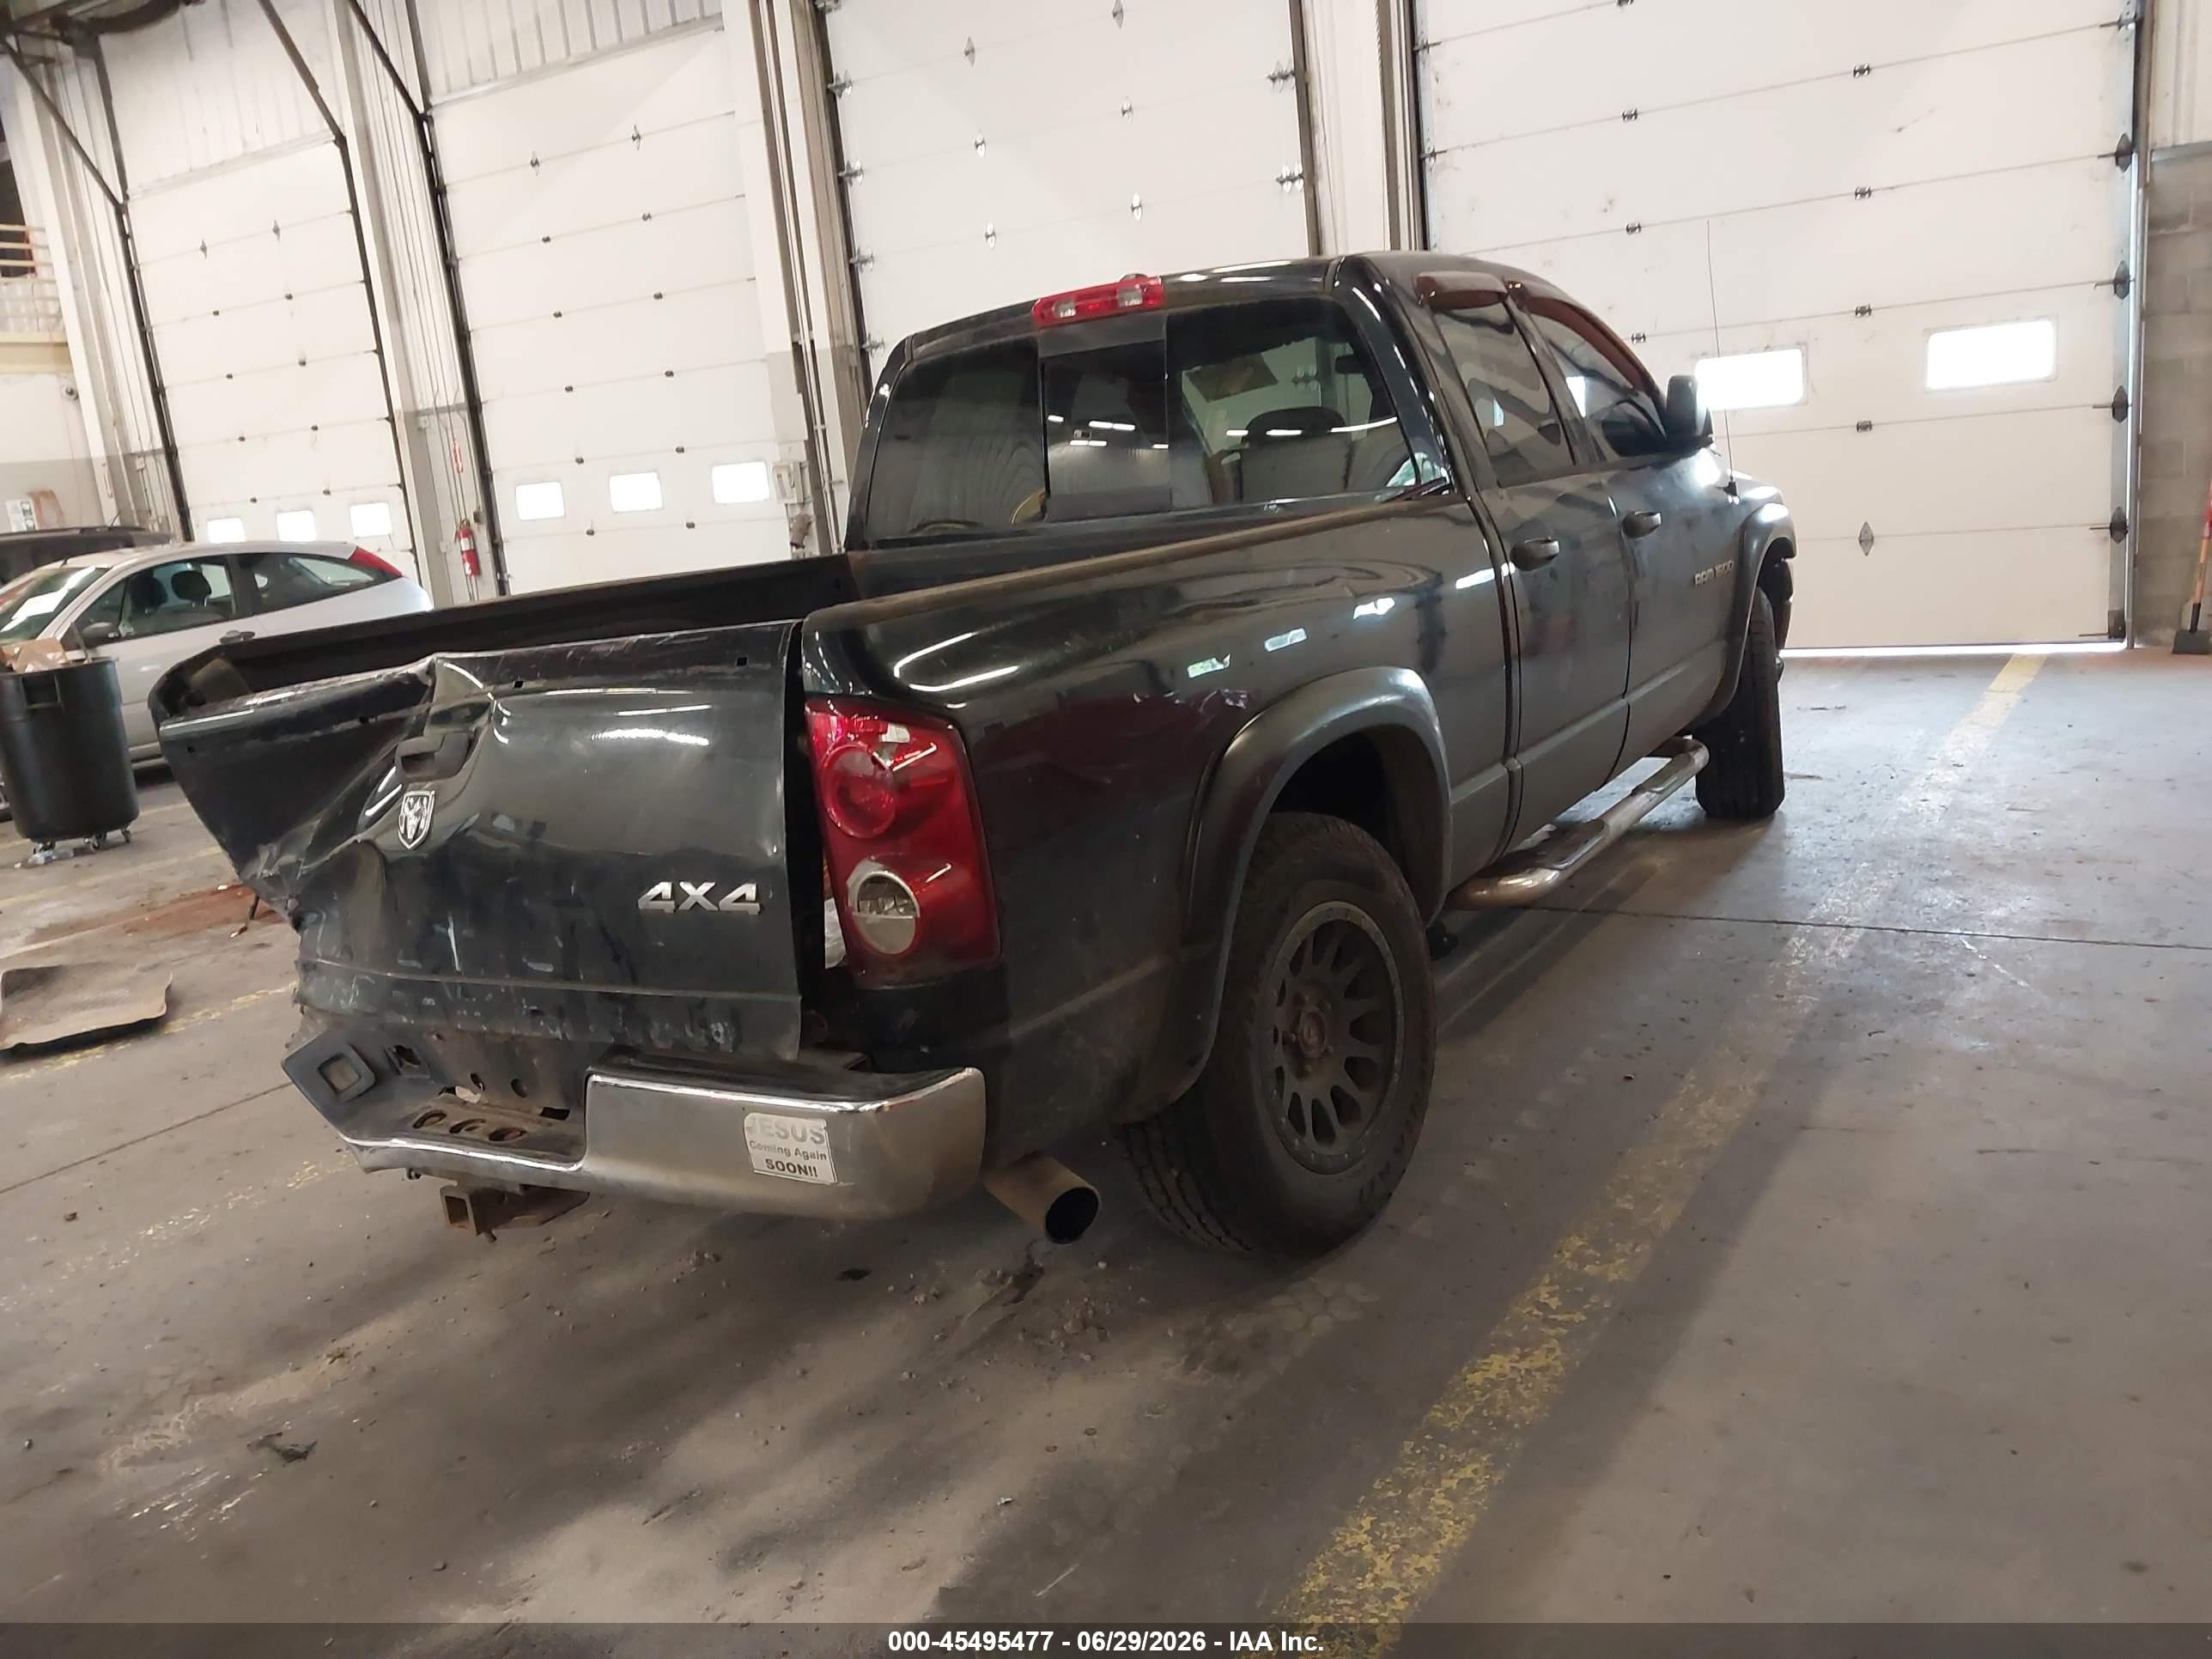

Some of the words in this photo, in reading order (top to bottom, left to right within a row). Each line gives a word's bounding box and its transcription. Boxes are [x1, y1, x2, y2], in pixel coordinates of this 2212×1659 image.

[637, 881, 761, 915] 4X4
[794, 1147, 827, 1161] Again
[765, 1158, 818, 1177] SOON!!
